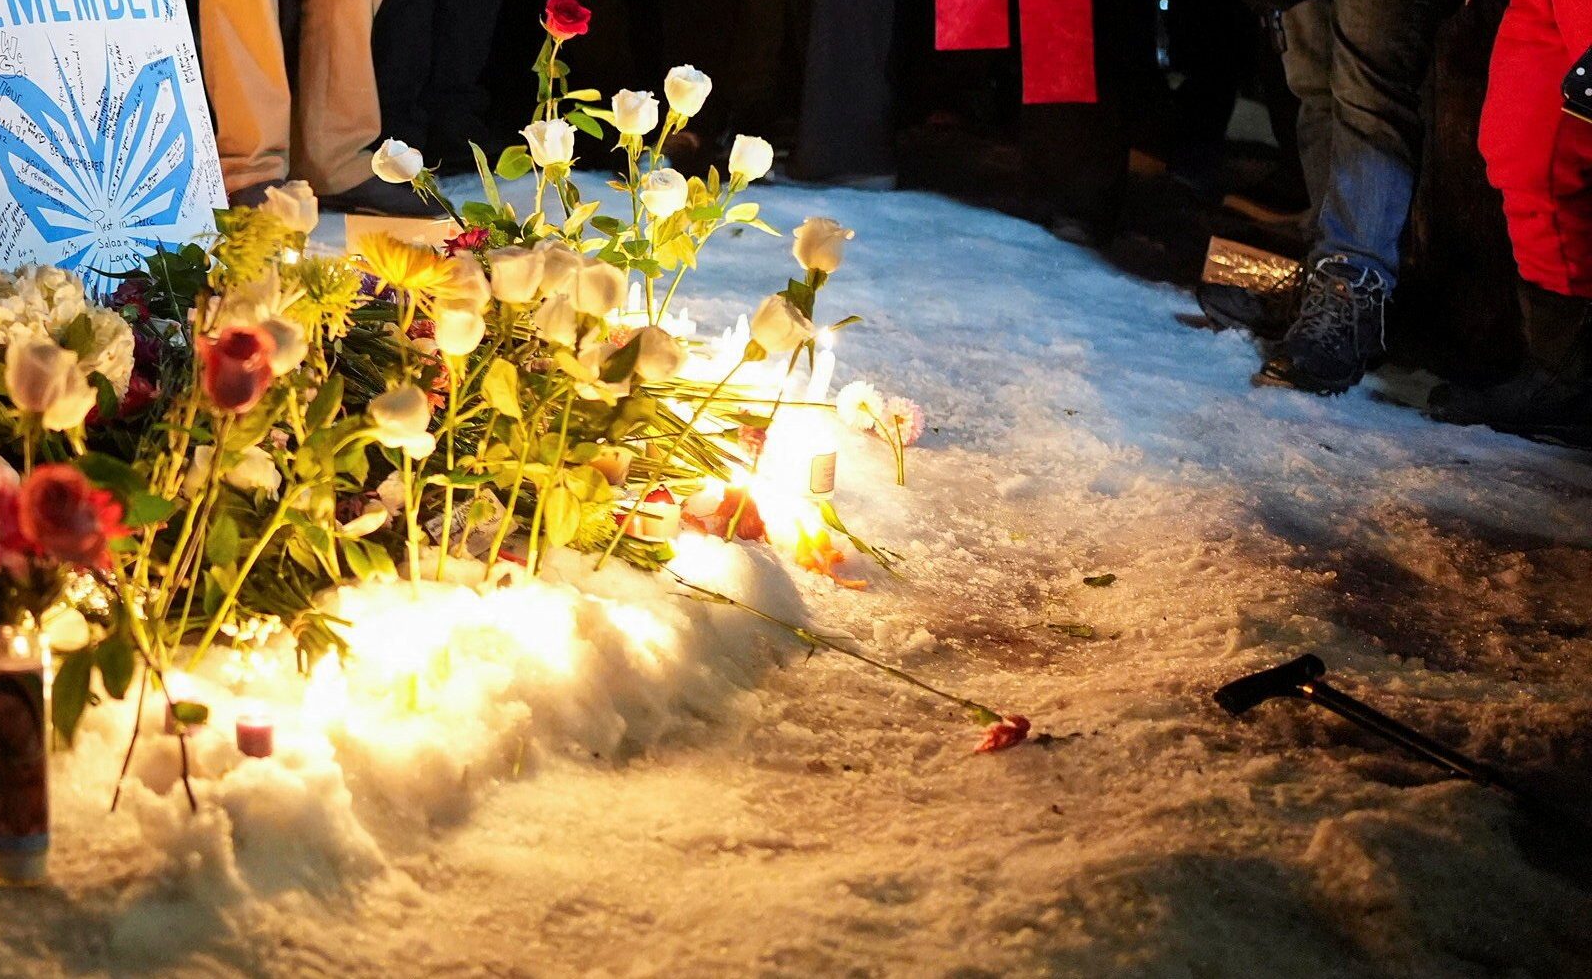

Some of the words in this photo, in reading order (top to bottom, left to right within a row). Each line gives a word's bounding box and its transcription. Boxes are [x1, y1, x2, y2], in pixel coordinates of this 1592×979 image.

[1, 30, 22, 64] We
[61, 155, 105, 174] REMEMBERED
[86, 209, 113, 233] Rest
[130, 215, 156, 229] Peace
[97, 238, 129, 250] Salaam
[110, 253, 130, 264] Love
